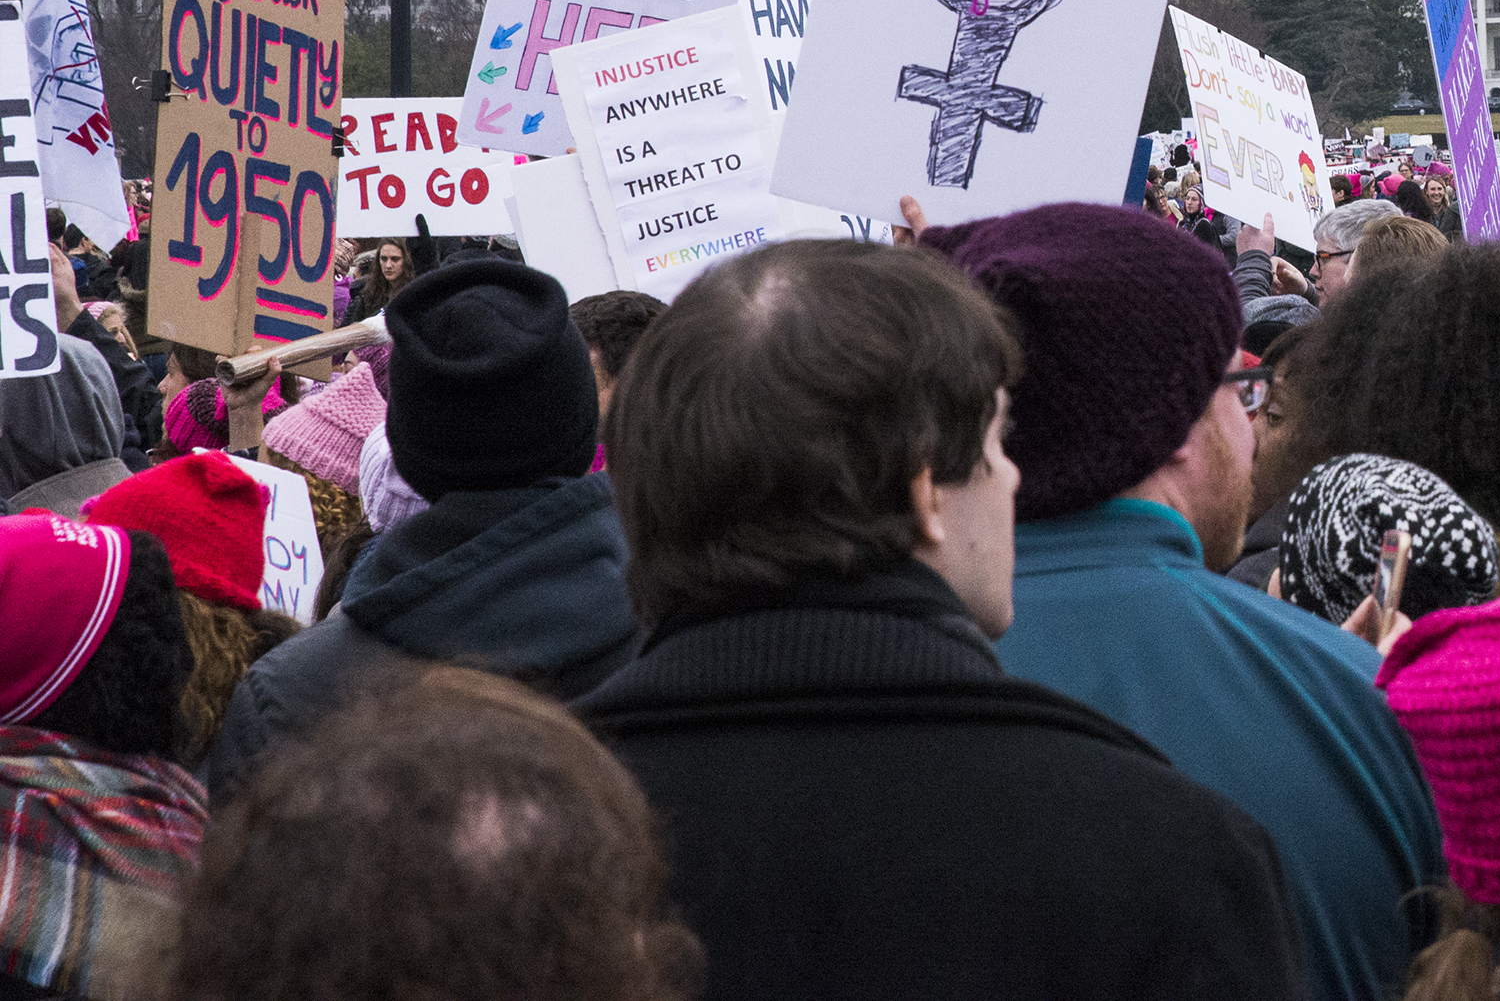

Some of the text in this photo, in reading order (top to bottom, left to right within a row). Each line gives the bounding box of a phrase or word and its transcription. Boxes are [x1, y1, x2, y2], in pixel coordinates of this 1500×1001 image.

[594, 47, 699, 88] INJUSTICE
[1173, 11, 1305, 100] Hush little BABY
[606, 78, 726, 124] ANYWHERE
[1183, 49, 1313, 142] Don't say a word
[229, 108, 268, 157] TO
[340, 112, 490, 156] READ
[616, 140, 657, 164] IS A
[1195, 101, 1294, 202] EVER.
[345, 166, 490, 210] TO GO
[624, 153, 742, 198] THREAT TO
[165, 132, 334, 301] 1950
[638, 203, 719, 241] JUSTICE
[646, 227, 768, 273] EVERYWHERE
